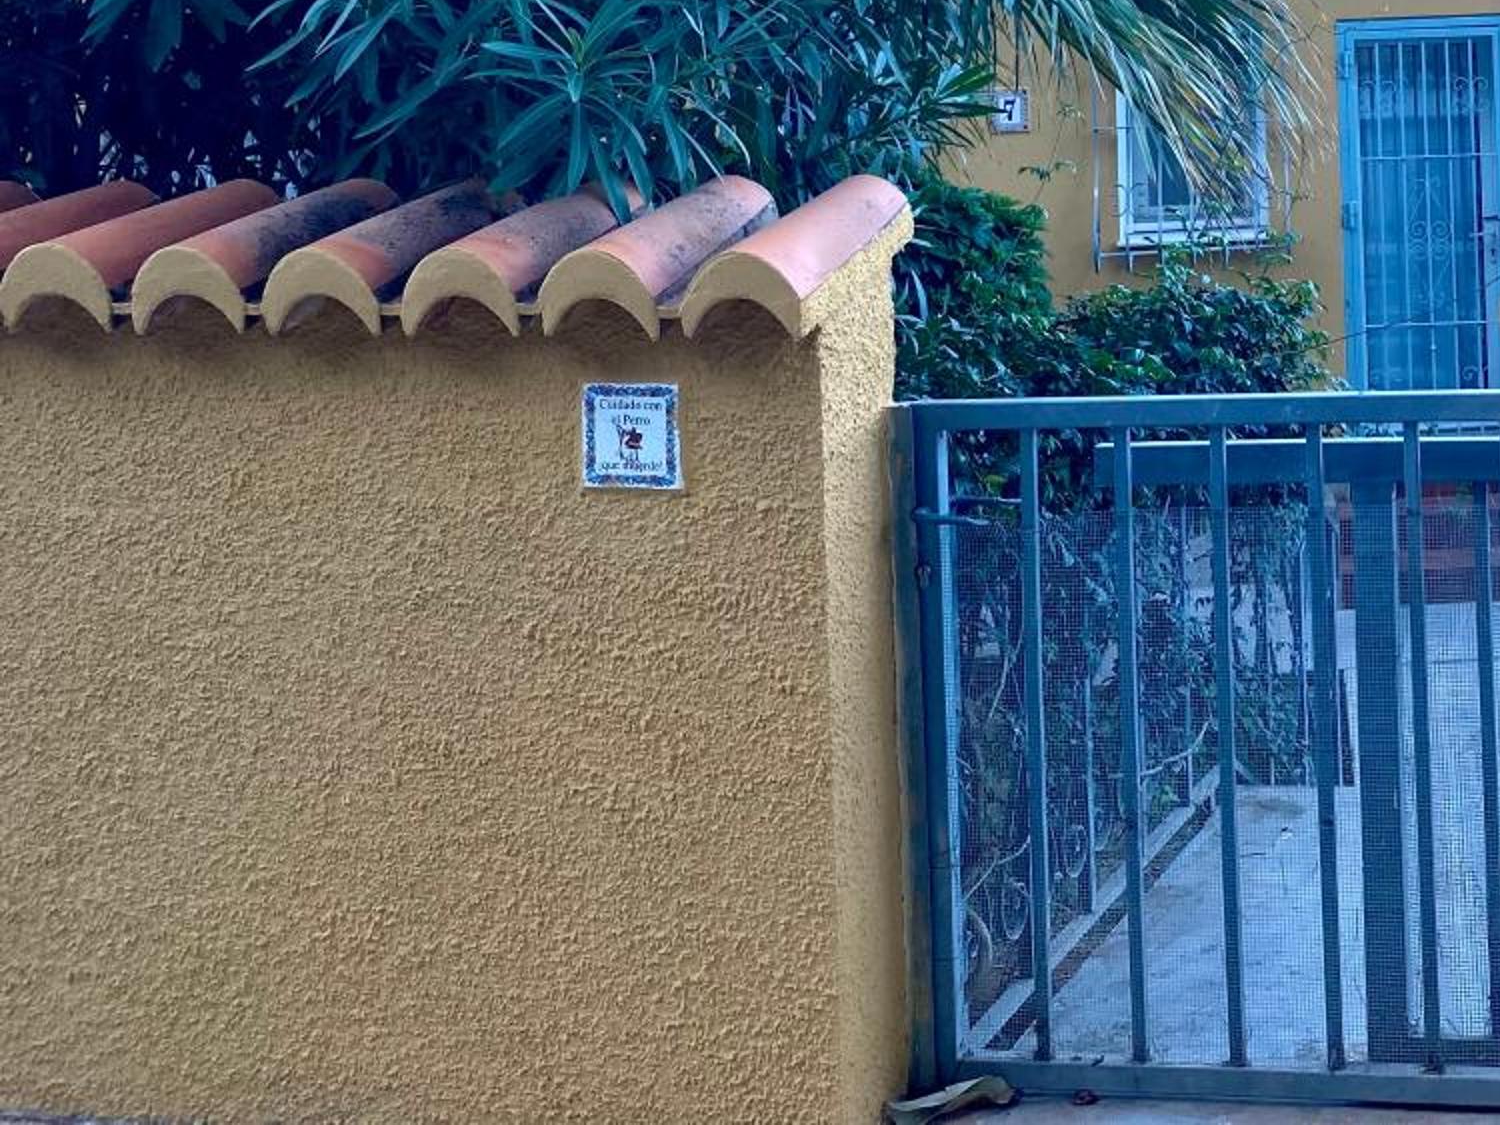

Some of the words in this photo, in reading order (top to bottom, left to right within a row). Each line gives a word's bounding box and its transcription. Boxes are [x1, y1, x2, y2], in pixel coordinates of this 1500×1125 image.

[1004, 99, 1016, 121] 7
[599, 399, 642, 410] Cuidado
[643, 401, 663, 411] con
[612, 414, 622, 425] el
[623, 414, 651, 426] Perro
